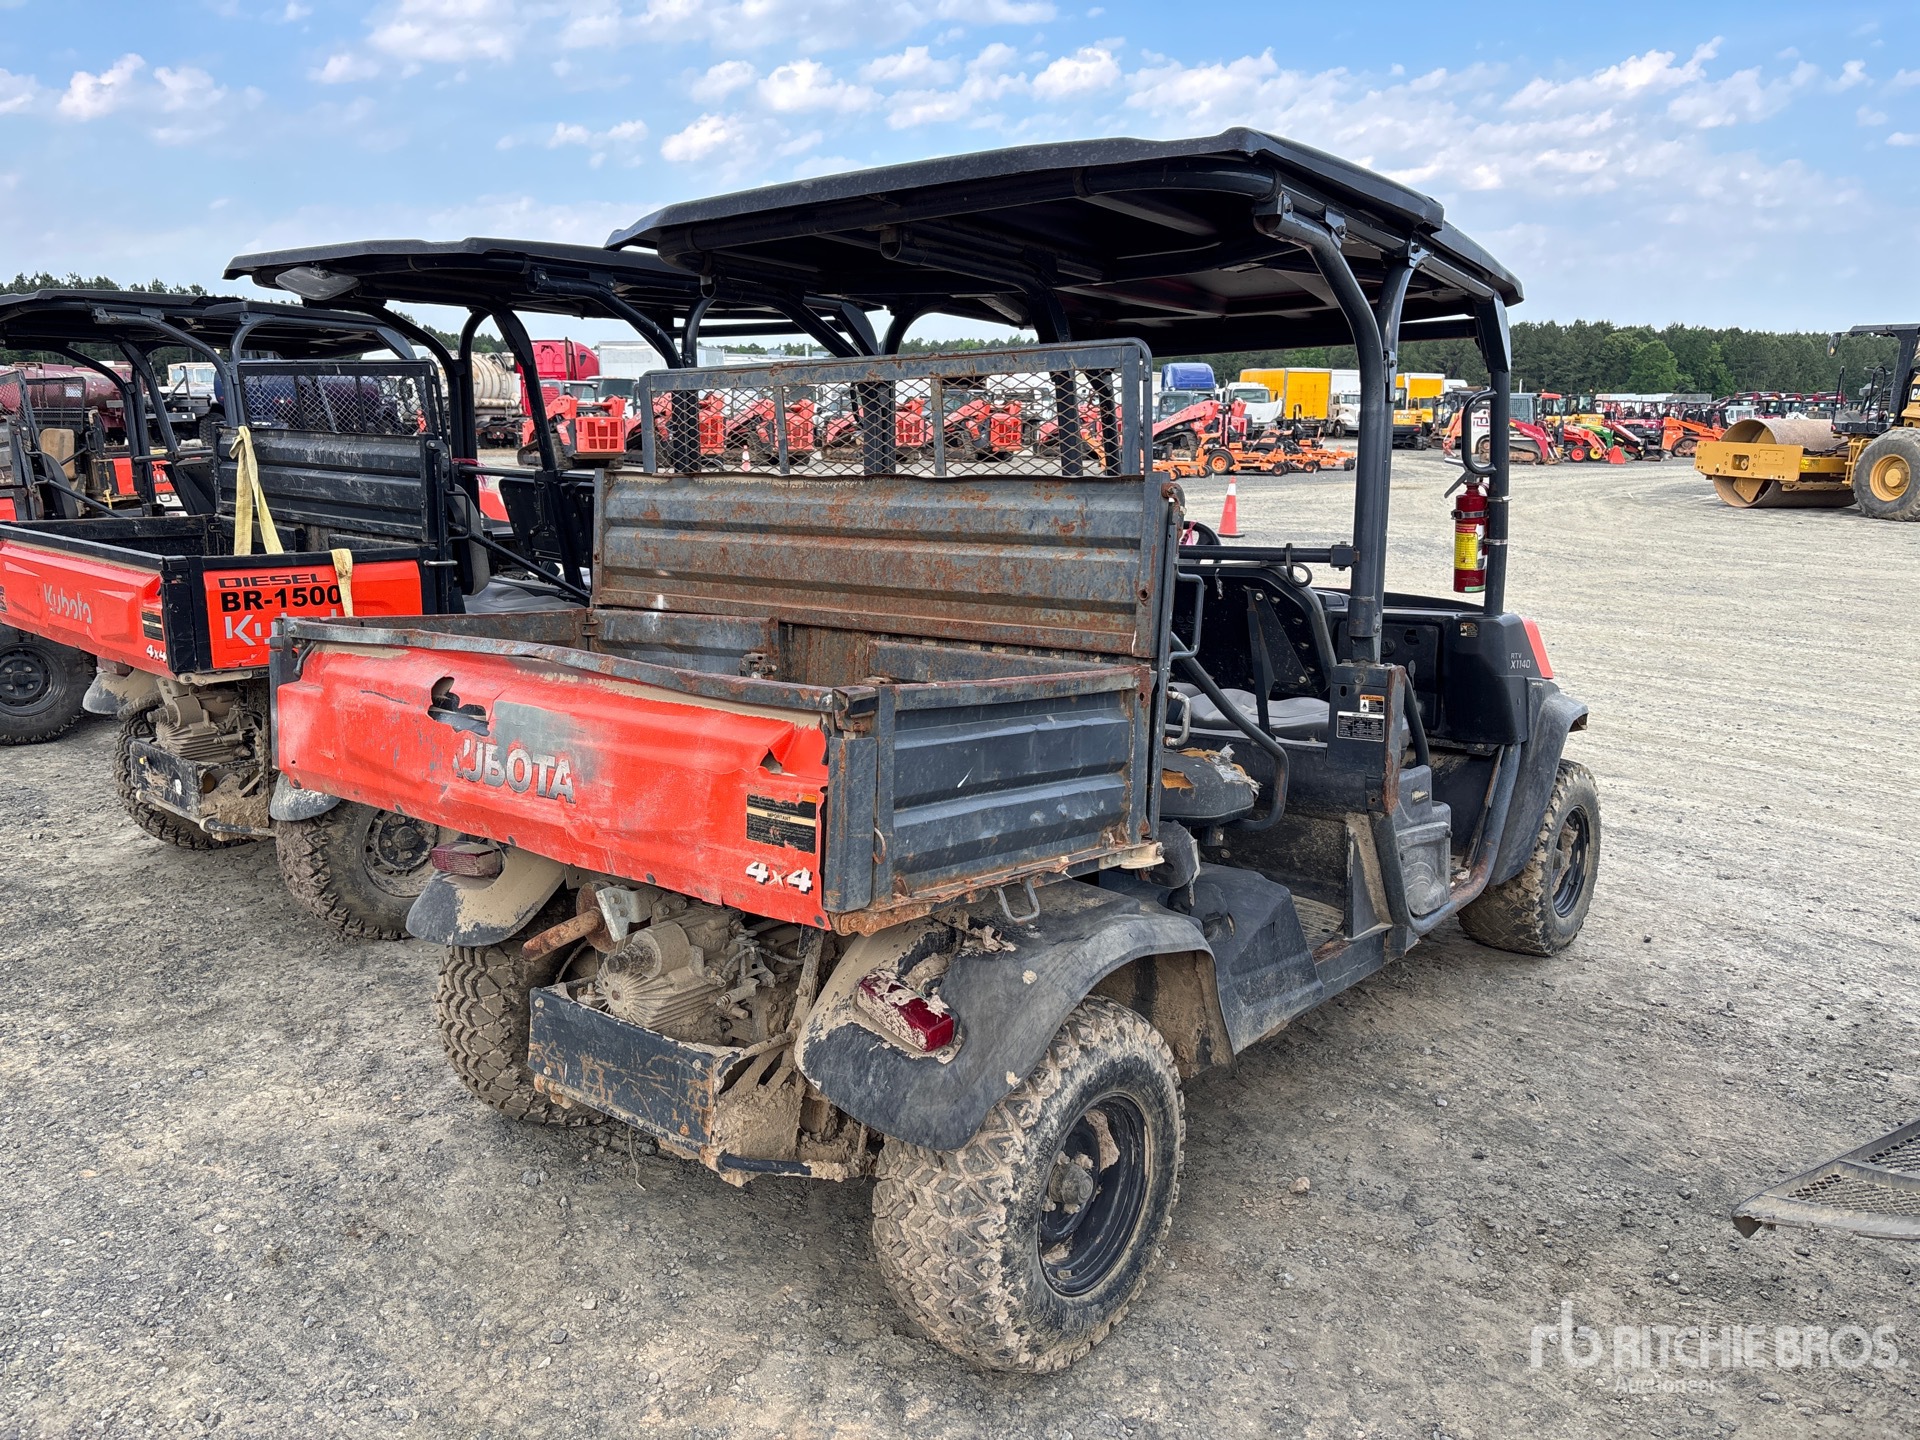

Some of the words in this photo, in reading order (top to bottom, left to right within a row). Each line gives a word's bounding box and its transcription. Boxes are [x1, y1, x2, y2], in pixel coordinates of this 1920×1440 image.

[218, 573, 330, 589] DIESEL
[220, 584, 342, 612] BR-1500
[1509, 659, 1531, 670] X1140
[452, 738, 577, 805] UBOTA
[766, 812, 791, 822] IMPORTANT
[745, 861, 814, 895] 4x4
